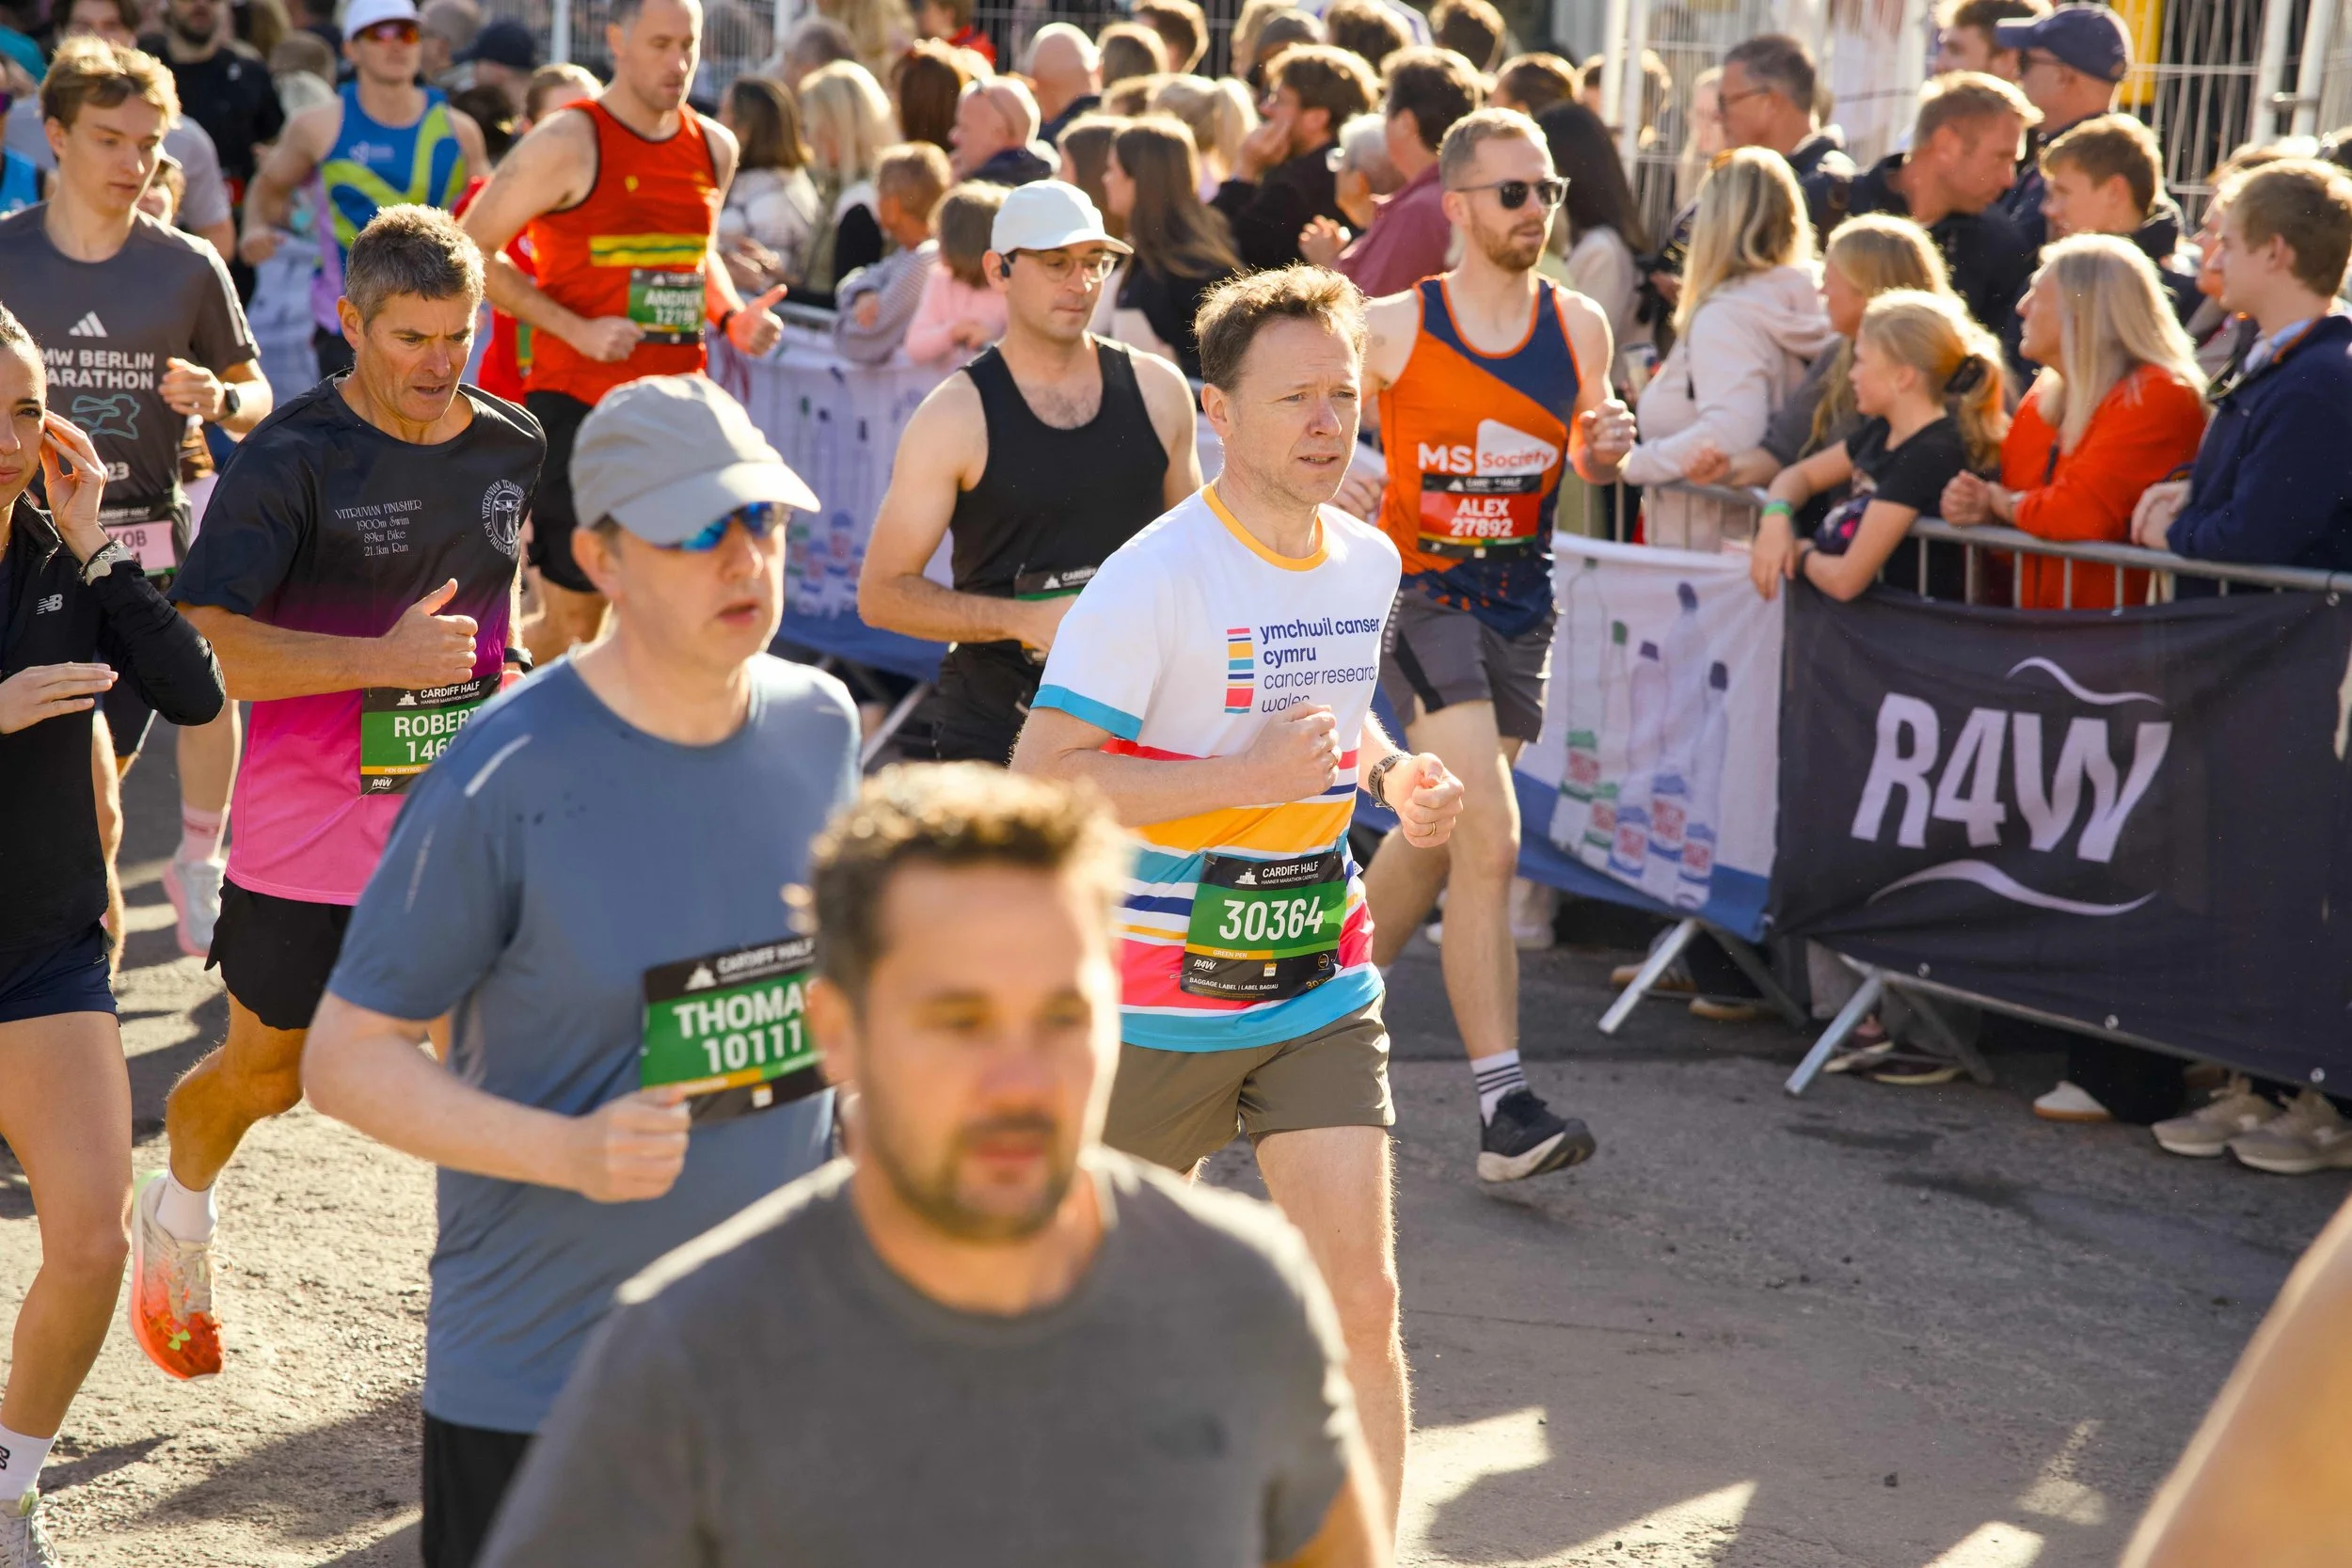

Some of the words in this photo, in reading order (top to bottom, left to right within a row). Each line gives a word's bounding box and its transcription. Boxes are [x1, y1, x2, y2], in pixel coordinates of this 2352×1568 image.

[40, 348, 74, 368] MW
[79, 350, 154, 370] BERLIN
[46, 368, 153, 389] ARATHON
[1418, 442, 1473, 474] MS
[1482, 449, 1551, 468] Society
[107, 462, 130, 482] 23
[335, 504, 382, 519] VITRUVIAN
[383, 499, 422, 514] FINISHER
[1456, 498, 1510, 517] ALEX
[357, 519, 388, 531] 1900m
[389, 515, 409, 527] Swim
[1450, 517, 1513, 537] 27892
[364, 531, 385, 543] 89km
[387, 530, 406, 541] Bike
[364, 545, 389, 557] 21.1km
[392, 543, 408, 553] Run
[1260, 618, 1333, 644] ymchwil
[1335, 618, 1380, 635] canser
[1263, 647, 1316, 669] cymru
[421, 686, 459, 698] CARDIFF
[461, 680, 481, 693] HALF
[1264, 671, 1320, 689] cancer
[406, 735, 458, 763] 146
[373, 778, 392, 787] R4W
[1851, 691, 2172, 863] R4W
[1262, 864, 1299, 878] CARDIFF
[1300, 861, 1319, 873] HALF
[1219, 895, 1324, 942] 30364
[1194, 958, 1217, 970] R4W
[1189, 977, 1217, 988] BAGGAGE
[672, 982, 805, 1038] THOMA
[702, 1019, 803, 1073] 10111
